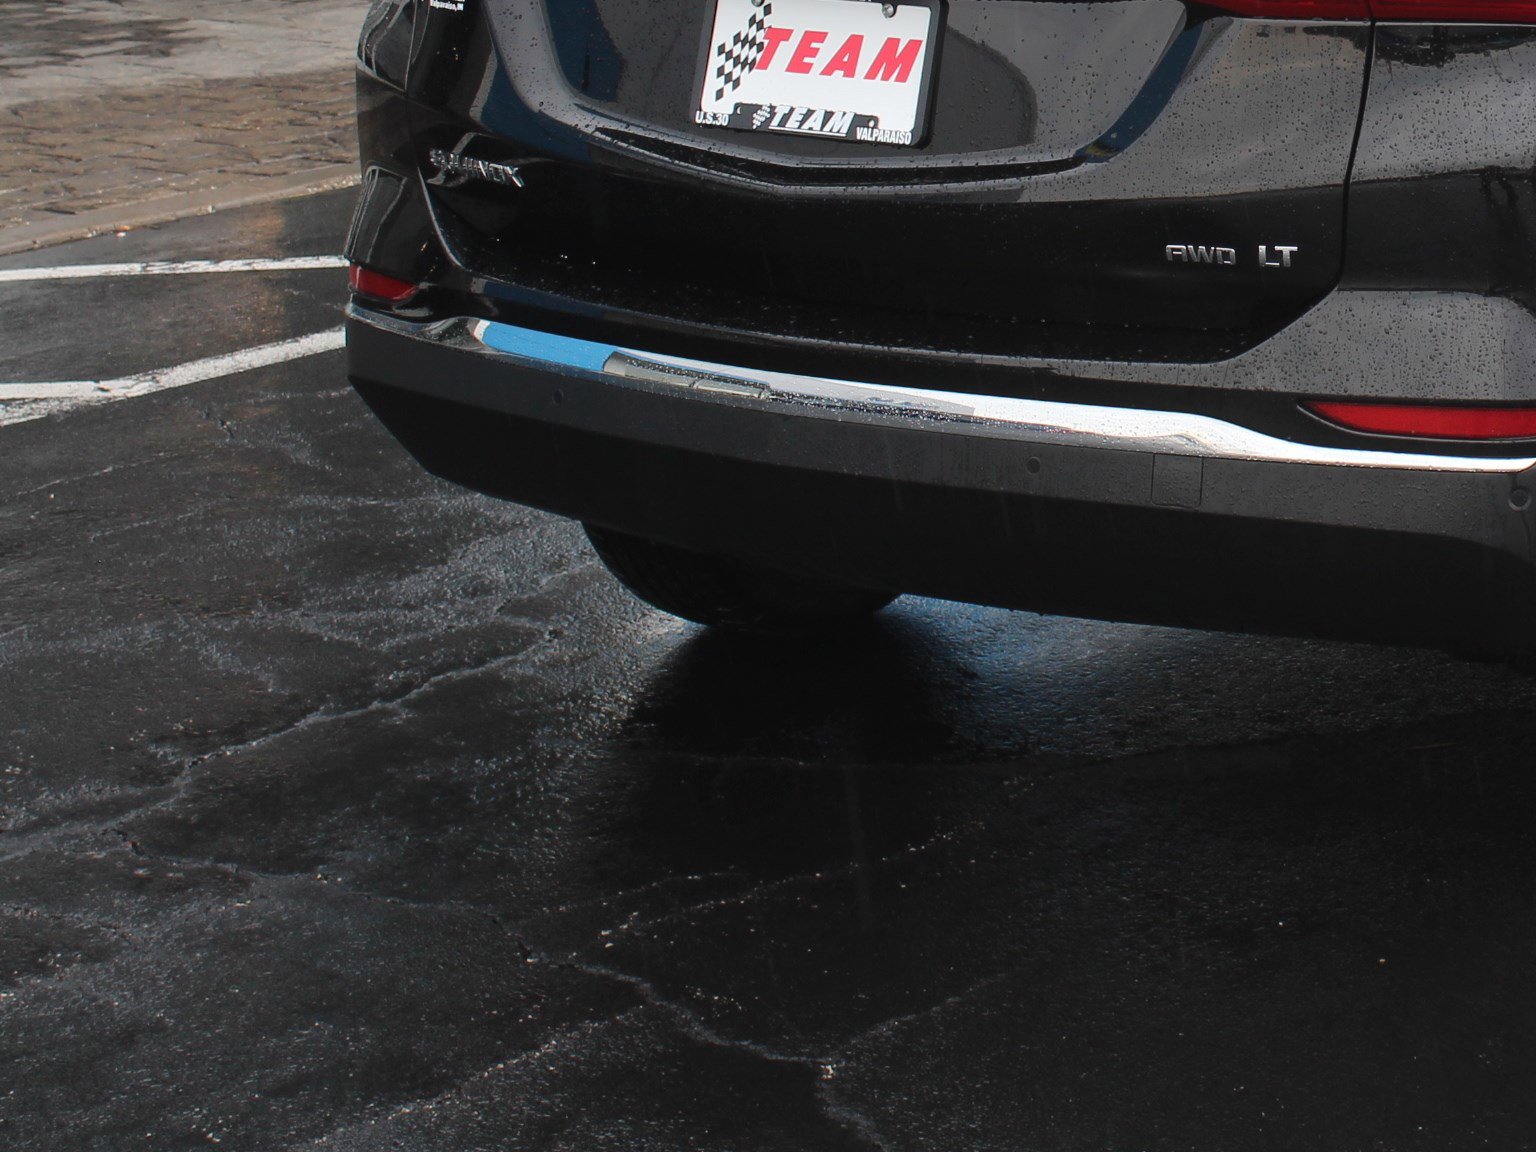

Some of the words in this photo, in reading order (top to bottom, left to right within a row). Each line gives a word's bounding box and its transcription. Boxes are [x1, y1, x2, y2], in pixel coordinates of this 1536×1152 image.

[754, 27, 924, 84] TEAM
[769, 104, 856, 135] TEAM
[856, 127, 912, 145] VALPARAISO
[1165, 244, 1236, 266] AWD
[1258, 245, 1298, 268] LT
